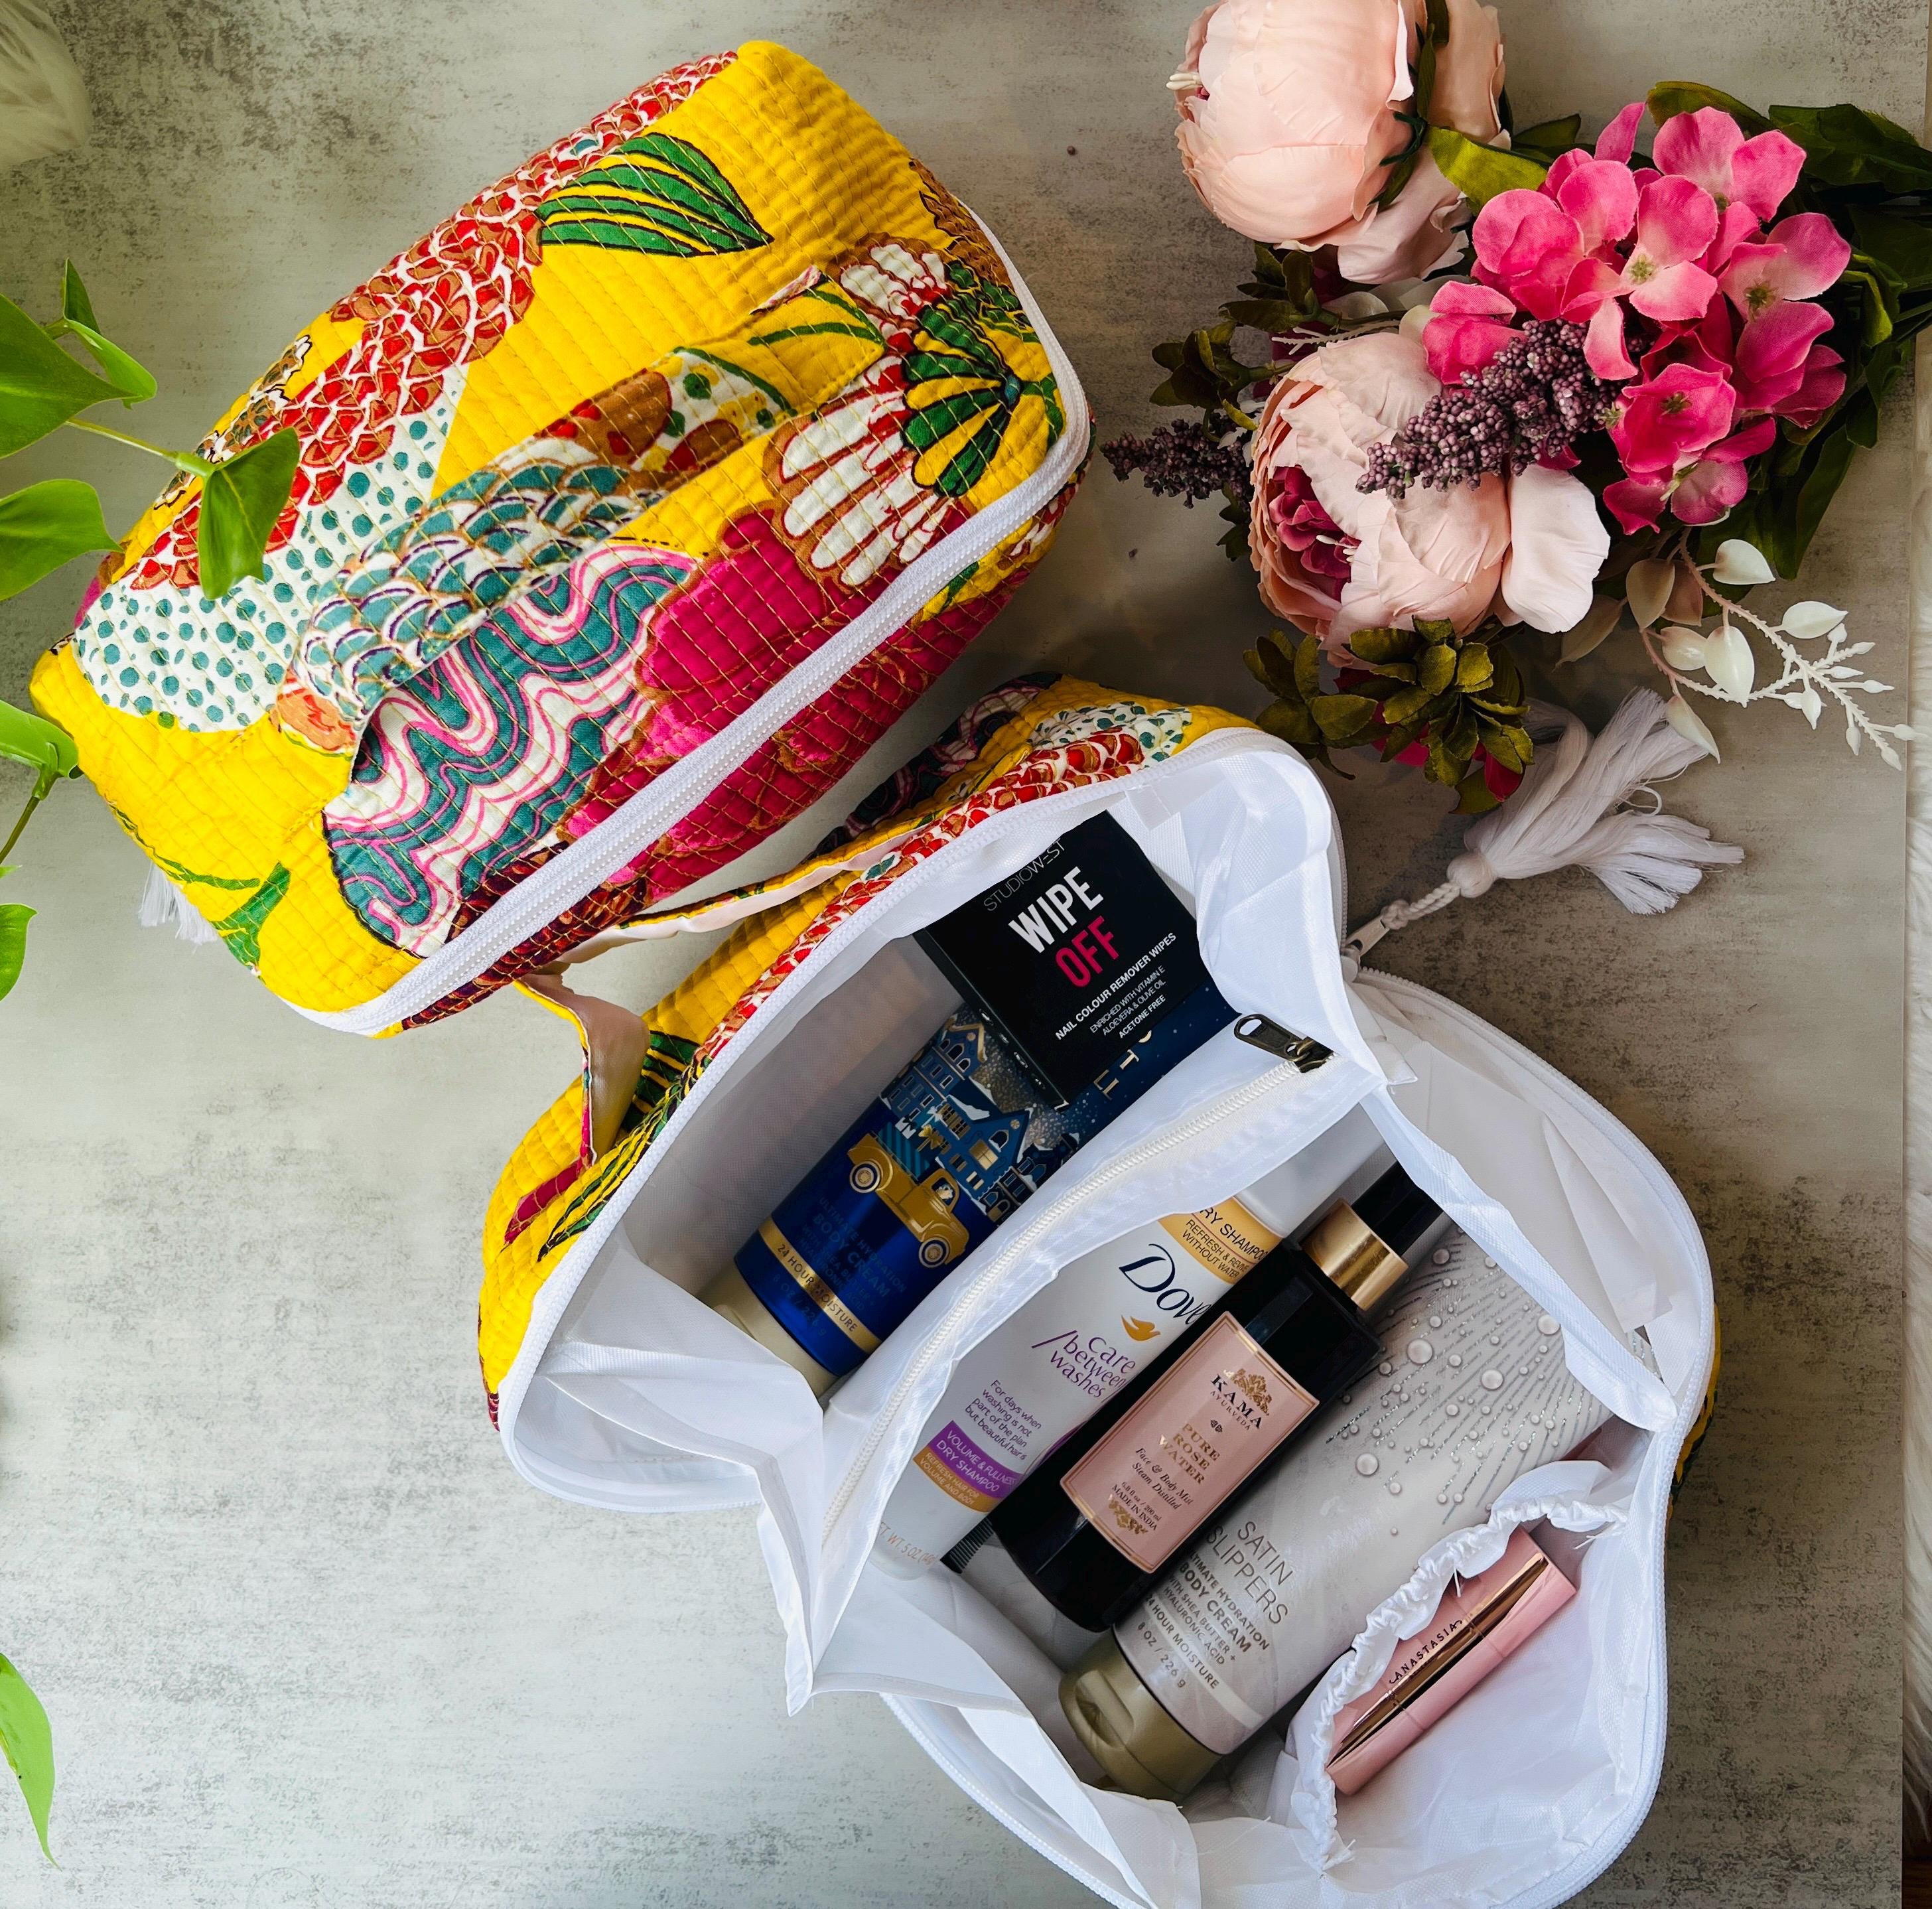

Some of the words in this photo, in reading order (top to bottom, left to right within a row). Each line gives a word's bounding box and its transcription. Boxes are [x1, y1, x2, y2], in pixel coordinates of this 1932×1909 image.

[1008, 866, 1104, 954] WIPE
[1056, 915, 1119, 988] OFF
[1055, 1021, 1077, 1040] NAIL
[1075, 989, 1112, 1022] COLOUR
[1110, 955, 1151, 992] REMOVER
[1149, 932, 1176, 957] WIPES
[1089, 1004, 1121, 1033] ENRICHED
[1120, 990, 1137, 1007] WITH
[1135, 970, 1160, 993] VITAMIN
[1158, 965, 1166, 974] E
[1102, 1007, 1135, 1036] ALOEVERA
[1137, 987, 1156, 1004] OLIVE
[1154, 979, 1166, 989] OIL
[1119, 1009, 1149, 1038] ACETONE
[1148, 995, 1166, 1012] FREE
[813, 1213, 849, 1250] BODY
[847, 1251, 890, 1297] CREAM
[1182, 1229, 1221, 1265] WITHOUT
[1217, 1261, 1240, 1278] WATER
[1186, 1219, 1225, 1256] REFRESH
[1228, 1257, 1249, 1272] REVIVE
[1200, 1207, 1223, 1224] RY
[1220, 1224, 1269, 1260] SHAMPO
[777, 1244, 790, 1257] 24
[788, 1257, 814, 1285] HOUR
[813, 1283, 858, 1332] MOISTURE
[1119, 1243, 1211, 1325] Dove
[1050, 1350, 1106, 1397] washes
[1064, 1334, 1127, 1387] between
[971, 1397, 991, 1416] part
[989, 1415, 1002, 1424] of
[999, 1423, 1012, 1437] the
[1009, 1435, 1027, 1448] plan
[983, 1389, 1012, 1421] washing
[1011, 1417, 1019, 1427] is
[1017, 1425, 1032, 1437] not
[991, 1380, 1006, 1396] For
[1004, 1397, 1022, 1414] days
[1021, 1412, 1042, 1429] when
[1210, 1390, 1251, 1431] AYURVEDA
[1211, 1374, 1263, 1429] KAMA
[965, 1404, 979, 1421] but
[977, 1418, 1011, 1449] beautiful
[1007, 1445, 1022, 1456] hair
[1173, 1433, 1210, 1470] ROSE
[1182, 1423, 1221, 1461] PURE
[920, 1458, 945, 1484] VOLUME
[945, 1483, 959, 1495] AND
[926, 1452, 953, 1480] REFRESH
[953, 1476, 968, 1493] HAIR
[967, 1488, 980, 1498] FOR
[936, 1440, 959, 1460] DRY
[956, 1460, 1000, 1492] SHAMPOO
[947, 1430, 981, 1465] VOLUME
[984, 1465, 1017, 1485] FULLNESS
[1136, 1448, 1152, 1464] Face
[1152, 1464, 1163, 1473] &
[1160, 1474, 1177, 1491] Body
[1176, 1489, 1194, 1505] Mist
[1159, 1435, 1205, 1484] WATER
[1112, 1484, 1133, 1507] MADE
[1131, 1504, 1141, 1514] IN
[1138, 1512, 1158, 1531] INDIA
[1132, 1462, 1152, 1484] Steam
[1152, 1483, 1182, 1510] Distilled
[1144, 1505, 1155, 1516] 200
[1206, 1526, 1288, 1624] SLIPPERS
[1237, 1521, 1293, 1585] SATIN
[1164, 1587, 1206, 1641] HYALURONIC
[1204, 1642, 1225, 1665] ACID
[1180, 1562, 1210, 1598] BODY
[1207, 1599, 1253, 1652] CREAM
[1182, 1593, 1200, 1618] SHEA
[1200, 1617, 1230, 1654] BUTTER
[1217, 1587, 1271, 1650] HYDRATION
[1144, 1630, 1157, 1647] OZ
[1160, 1654, 1179, 1677] 226
[1178, 1679, 1186, 1688] g
[1152, 1604, 1174, 1634] HOUR
[1172, 1633, 1219, 1689] MOISTURE
[1389, 1620, 1463, 1684] ANASTASIA
